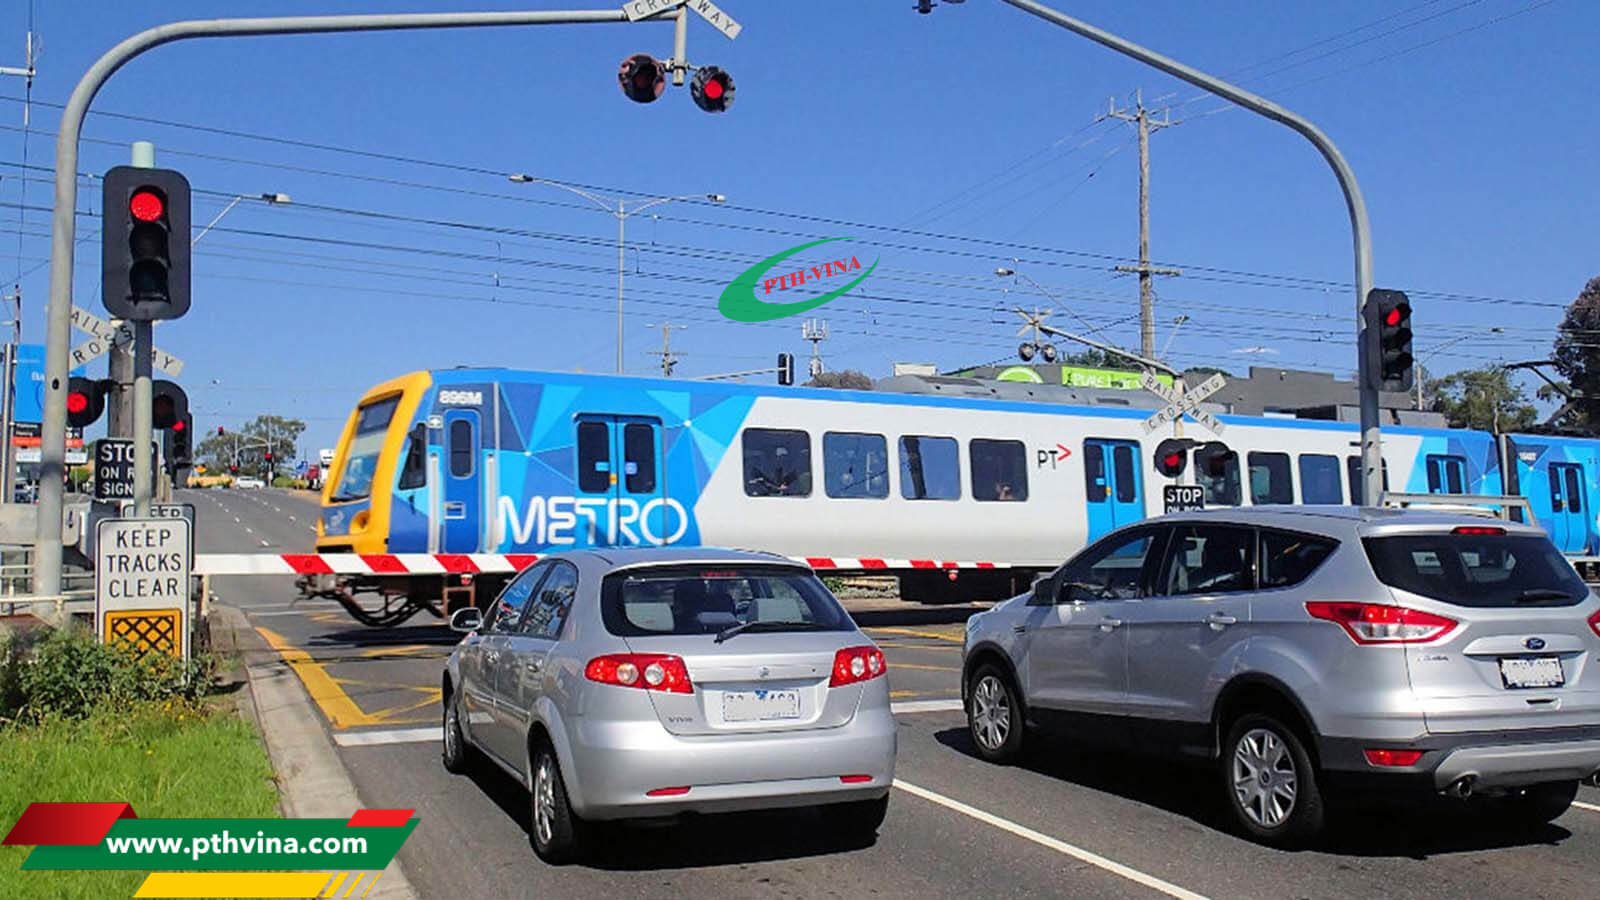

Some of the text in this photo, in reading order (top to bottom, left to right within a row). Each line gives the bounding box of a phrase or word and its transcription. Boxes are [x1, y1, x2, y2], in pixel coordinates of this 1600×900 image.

[101, 443, 136, 463] STO
[101, 466, 120, 480] ON
[102, 482, 134, 496] SIGN
[1167, 488, 1202, 503] STOP
[498, 496, 689, 545] METRO
[116, 529, 171, 548] KEEP
[106, 553, 182, 572] TRACKS
[109, 578, 178, 598] CLEAR
